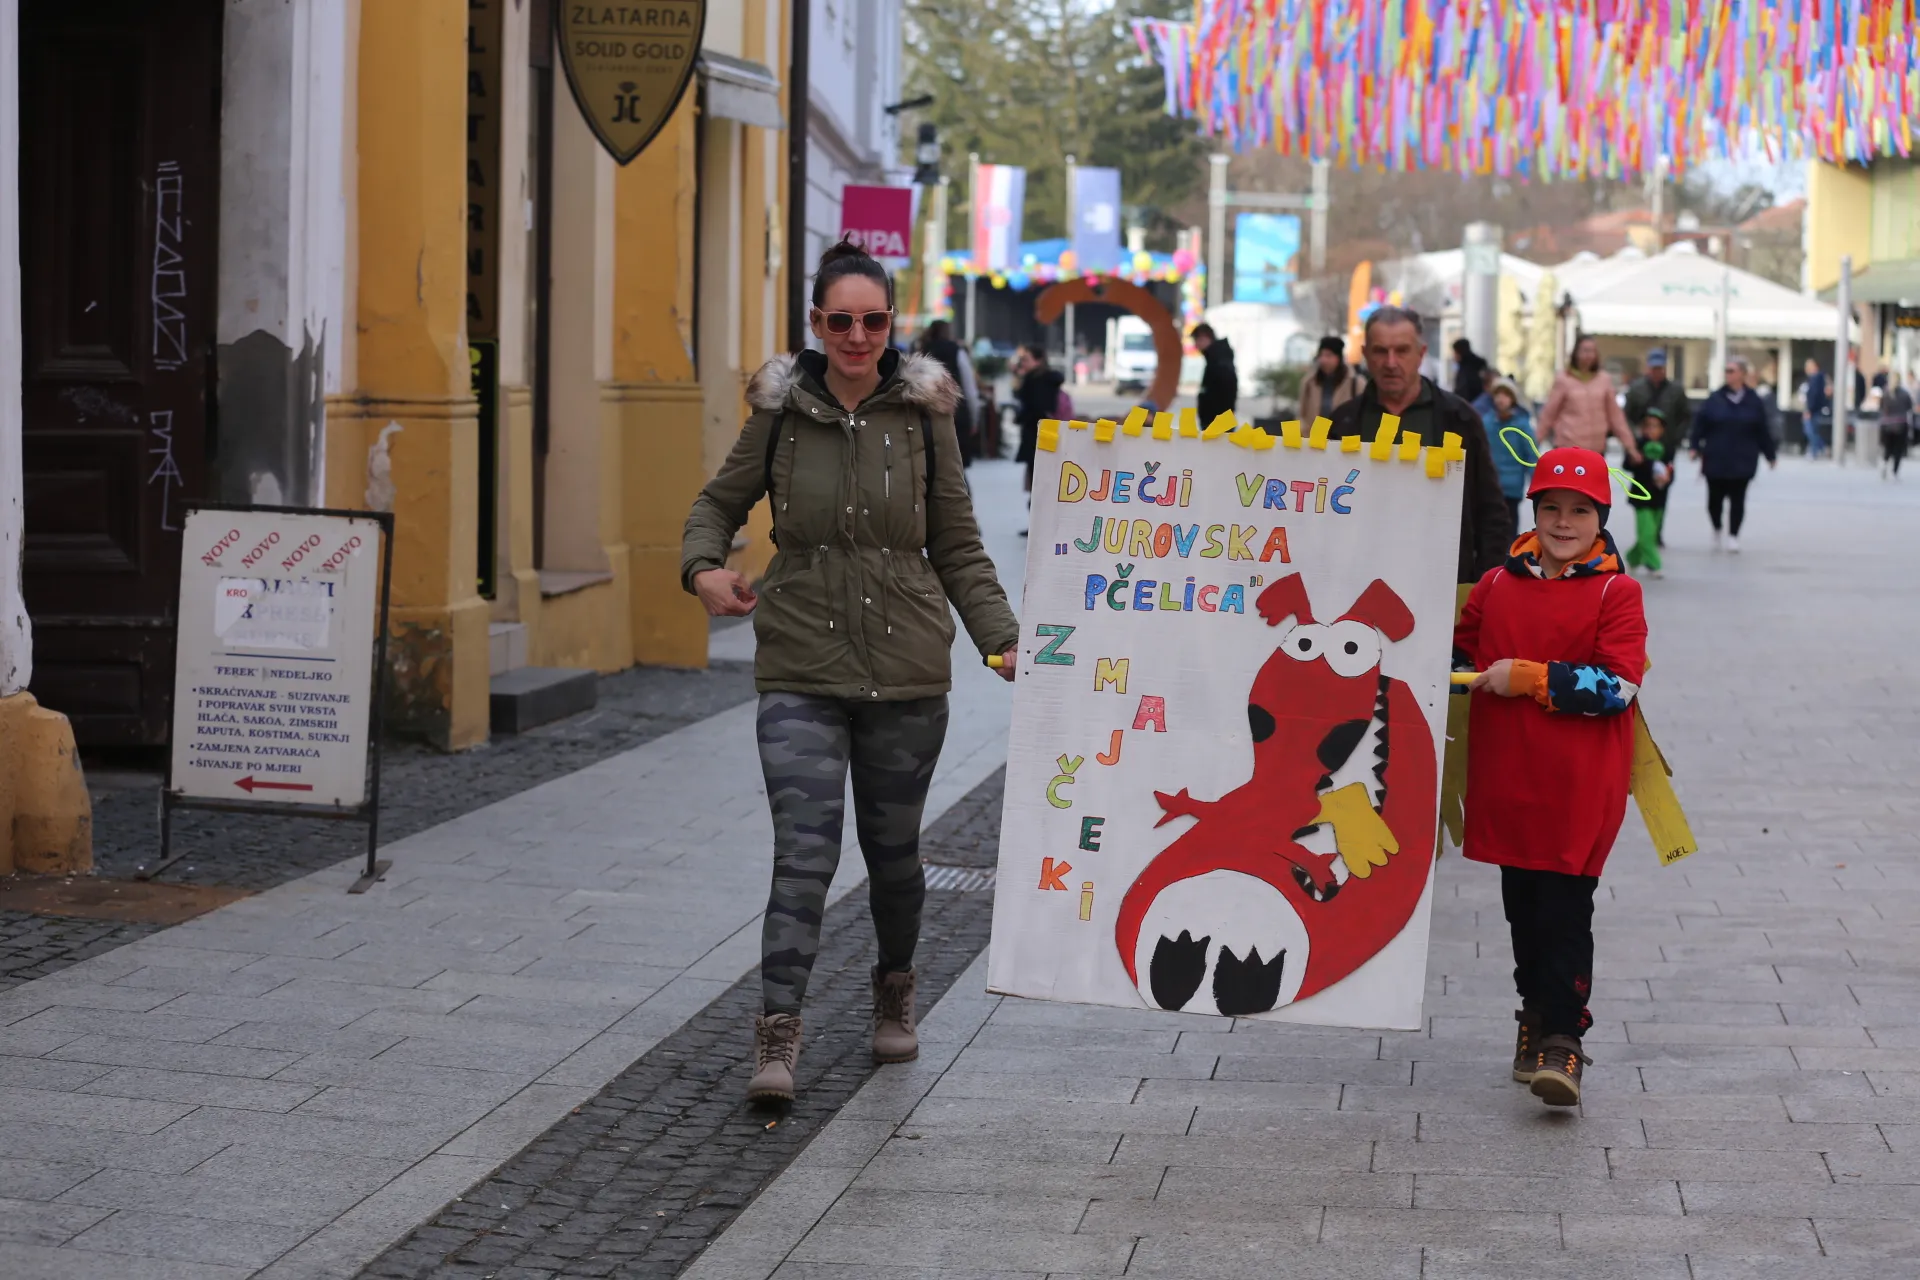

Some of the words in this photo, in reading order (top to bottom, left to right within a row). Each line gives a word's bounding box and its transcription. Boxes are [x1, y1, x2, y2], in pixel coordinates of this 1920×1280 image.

[572, 6, 691, 28] ZLATARNA
[633, 43, 684, 59] GOLD
[201, 529, 241, 566] NOVO
[241, 531, 280, 569] NOVO
[281, 534, 321, 572] NOVO
[321, 536, 362, 572] NOVO
[226, 588, 248, 598] KRO
[270, 669, 333, 682] NEDELJKO
[206, 700, 266, 712] POPRAVAK
[269, 704, 297, 713] SVIH
[300, 706, 337, 716] VRSTA
[289, 719, 338, 730] ZIMSKIH
[308, 733, 350, 744] SUKNJI
[196, 743, 251, 755] ZAMJENA
[247, 763, 263, 772] PO
[266, 763, 303, 774] MJERI
[1666, 846, 1689, 862] NOEL
